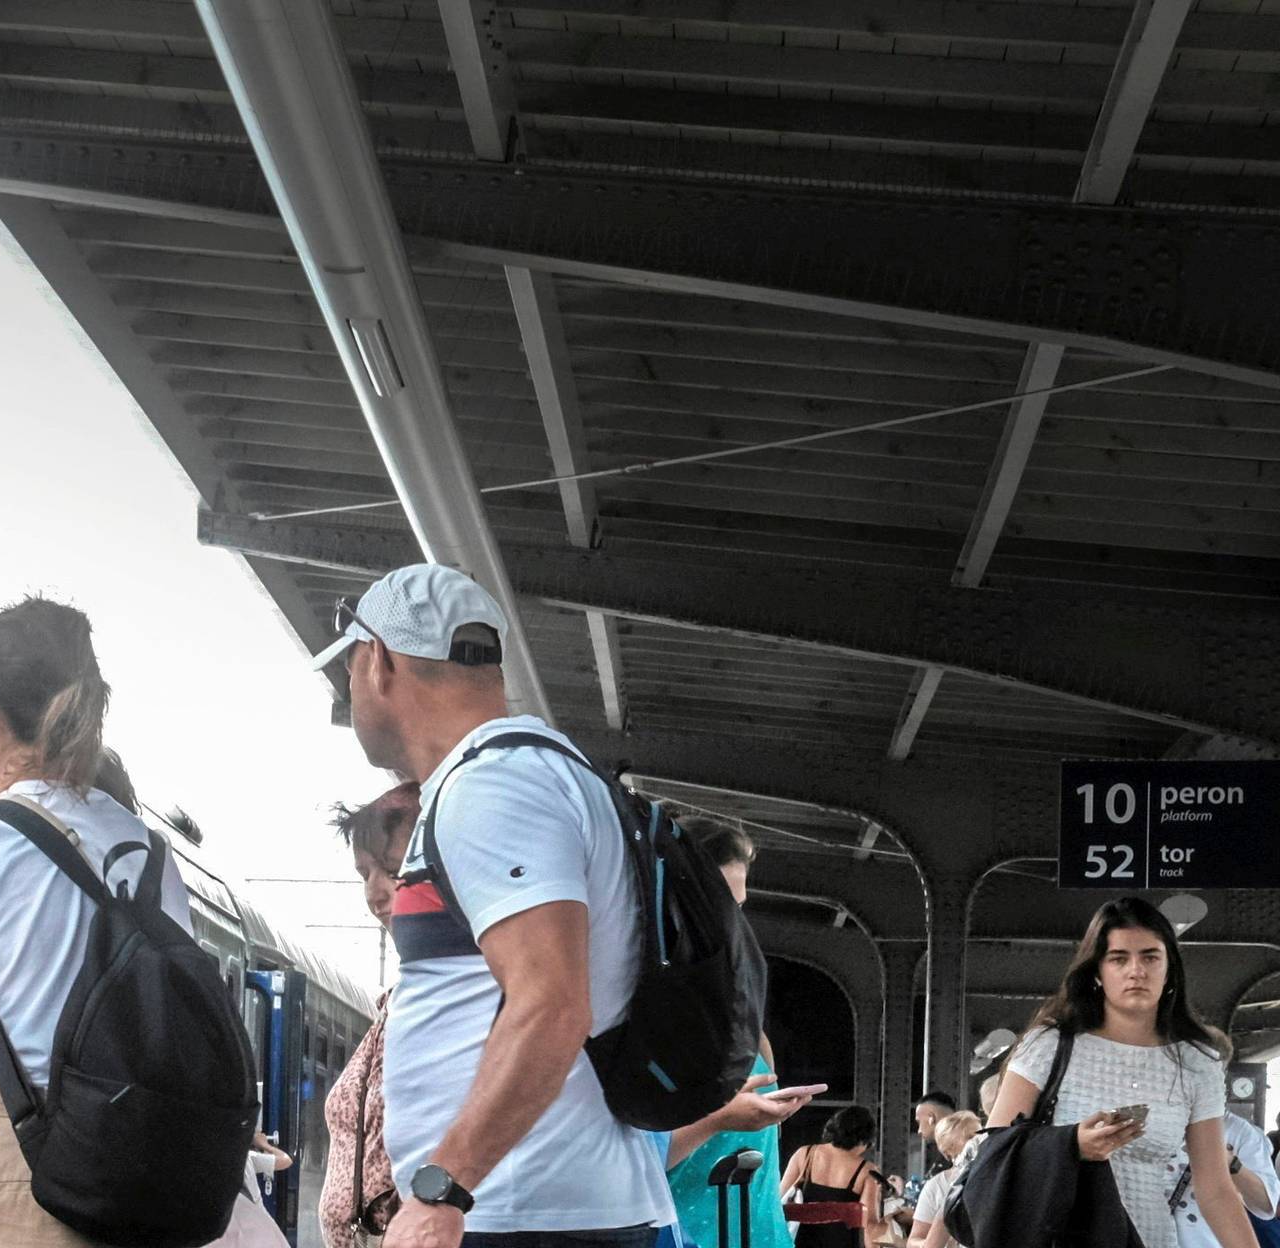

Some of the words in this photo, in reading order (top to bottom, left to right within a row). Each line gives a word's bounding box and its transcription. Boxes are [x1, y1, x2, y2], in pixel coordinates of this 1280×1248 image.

[1076, 783, 1137, 825] 10
[1160, 786, 1244, 810] peron
[1160, 809, 1213, 824] platform
[1084, 845, 1135, 879] 52
[1159, 845, 1195, 863] tor
[1159, 868, 1184, 878] track
